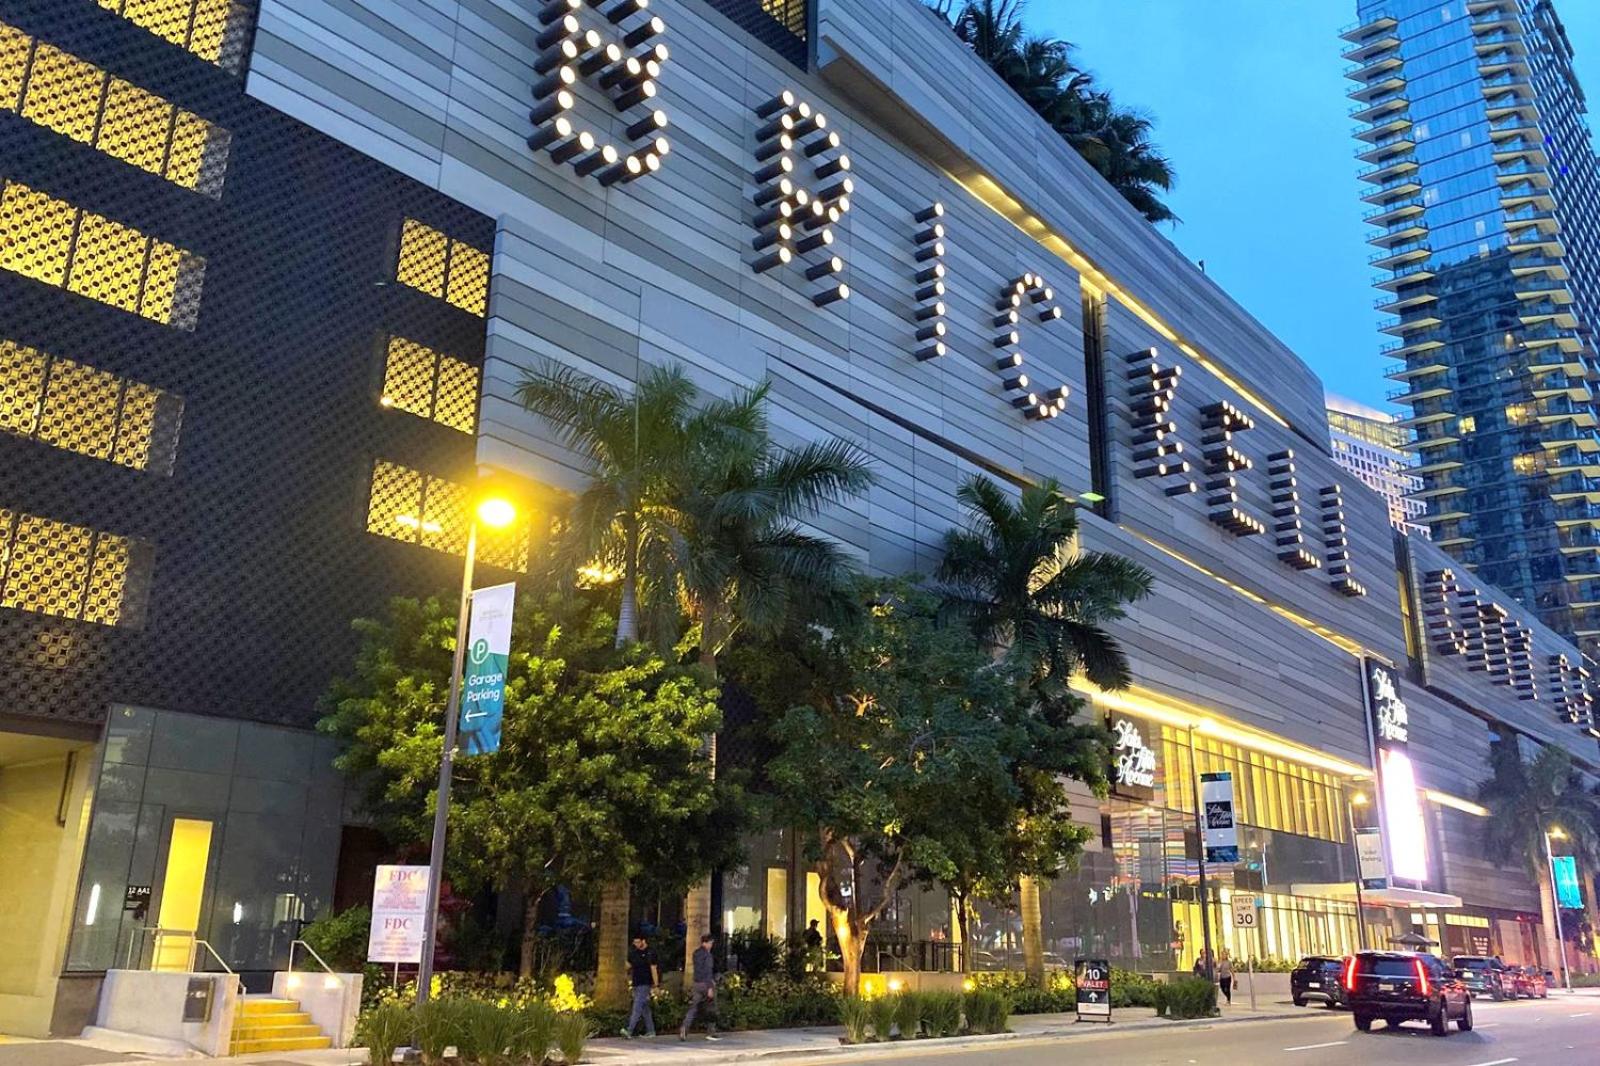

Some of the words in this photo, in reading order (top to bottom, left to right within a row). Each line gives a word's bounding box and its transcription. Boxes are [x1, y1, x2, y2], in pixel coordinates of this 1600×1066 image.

[527, 0, 1367, 598] BRICKELL
[469, 673, 502, 687] Garage
[467, 688, 500, 702] Parking
[389, 870, 416, 881] FDC
[384, 918, 411, 930] FDC
[1237, 913, 1253, 925] 30
[1087, 968, 1100, 980] 10
